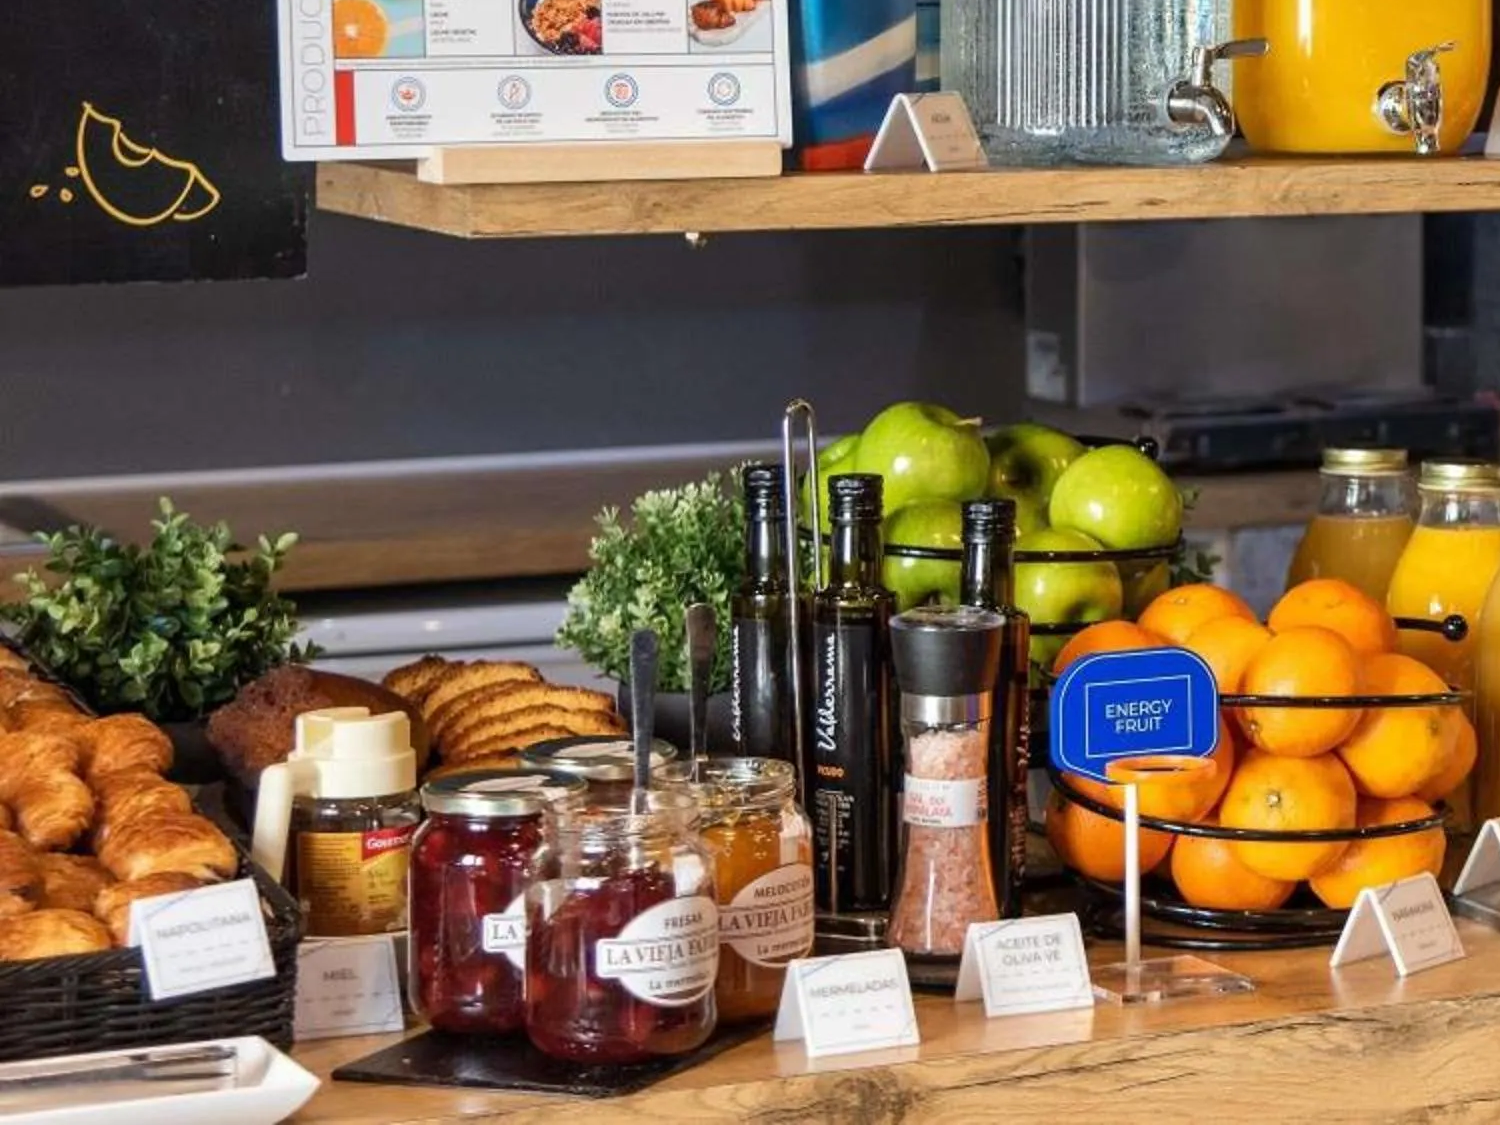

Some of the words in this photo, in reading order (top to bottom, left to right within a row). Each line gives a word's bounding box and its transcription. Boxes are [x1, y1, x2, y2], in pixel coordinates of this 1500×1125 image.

[1105, 698, 1173, 719] ENERGY
[1115, 716, 1164, 734] FRUIT
[492, 925, 517, 940] LA
[998, 936, 1040, 950] ACEITE
[1044, 932, 1062, 947] DE
[606, 949, 631, 966] LA
[635, 942, 684, 962] VIEJA
[1002, 951, 1042, 966] OLIVA
[323, 968, 358, 981] MIEL
[810, 977, 900, 998] MERMELADAS
